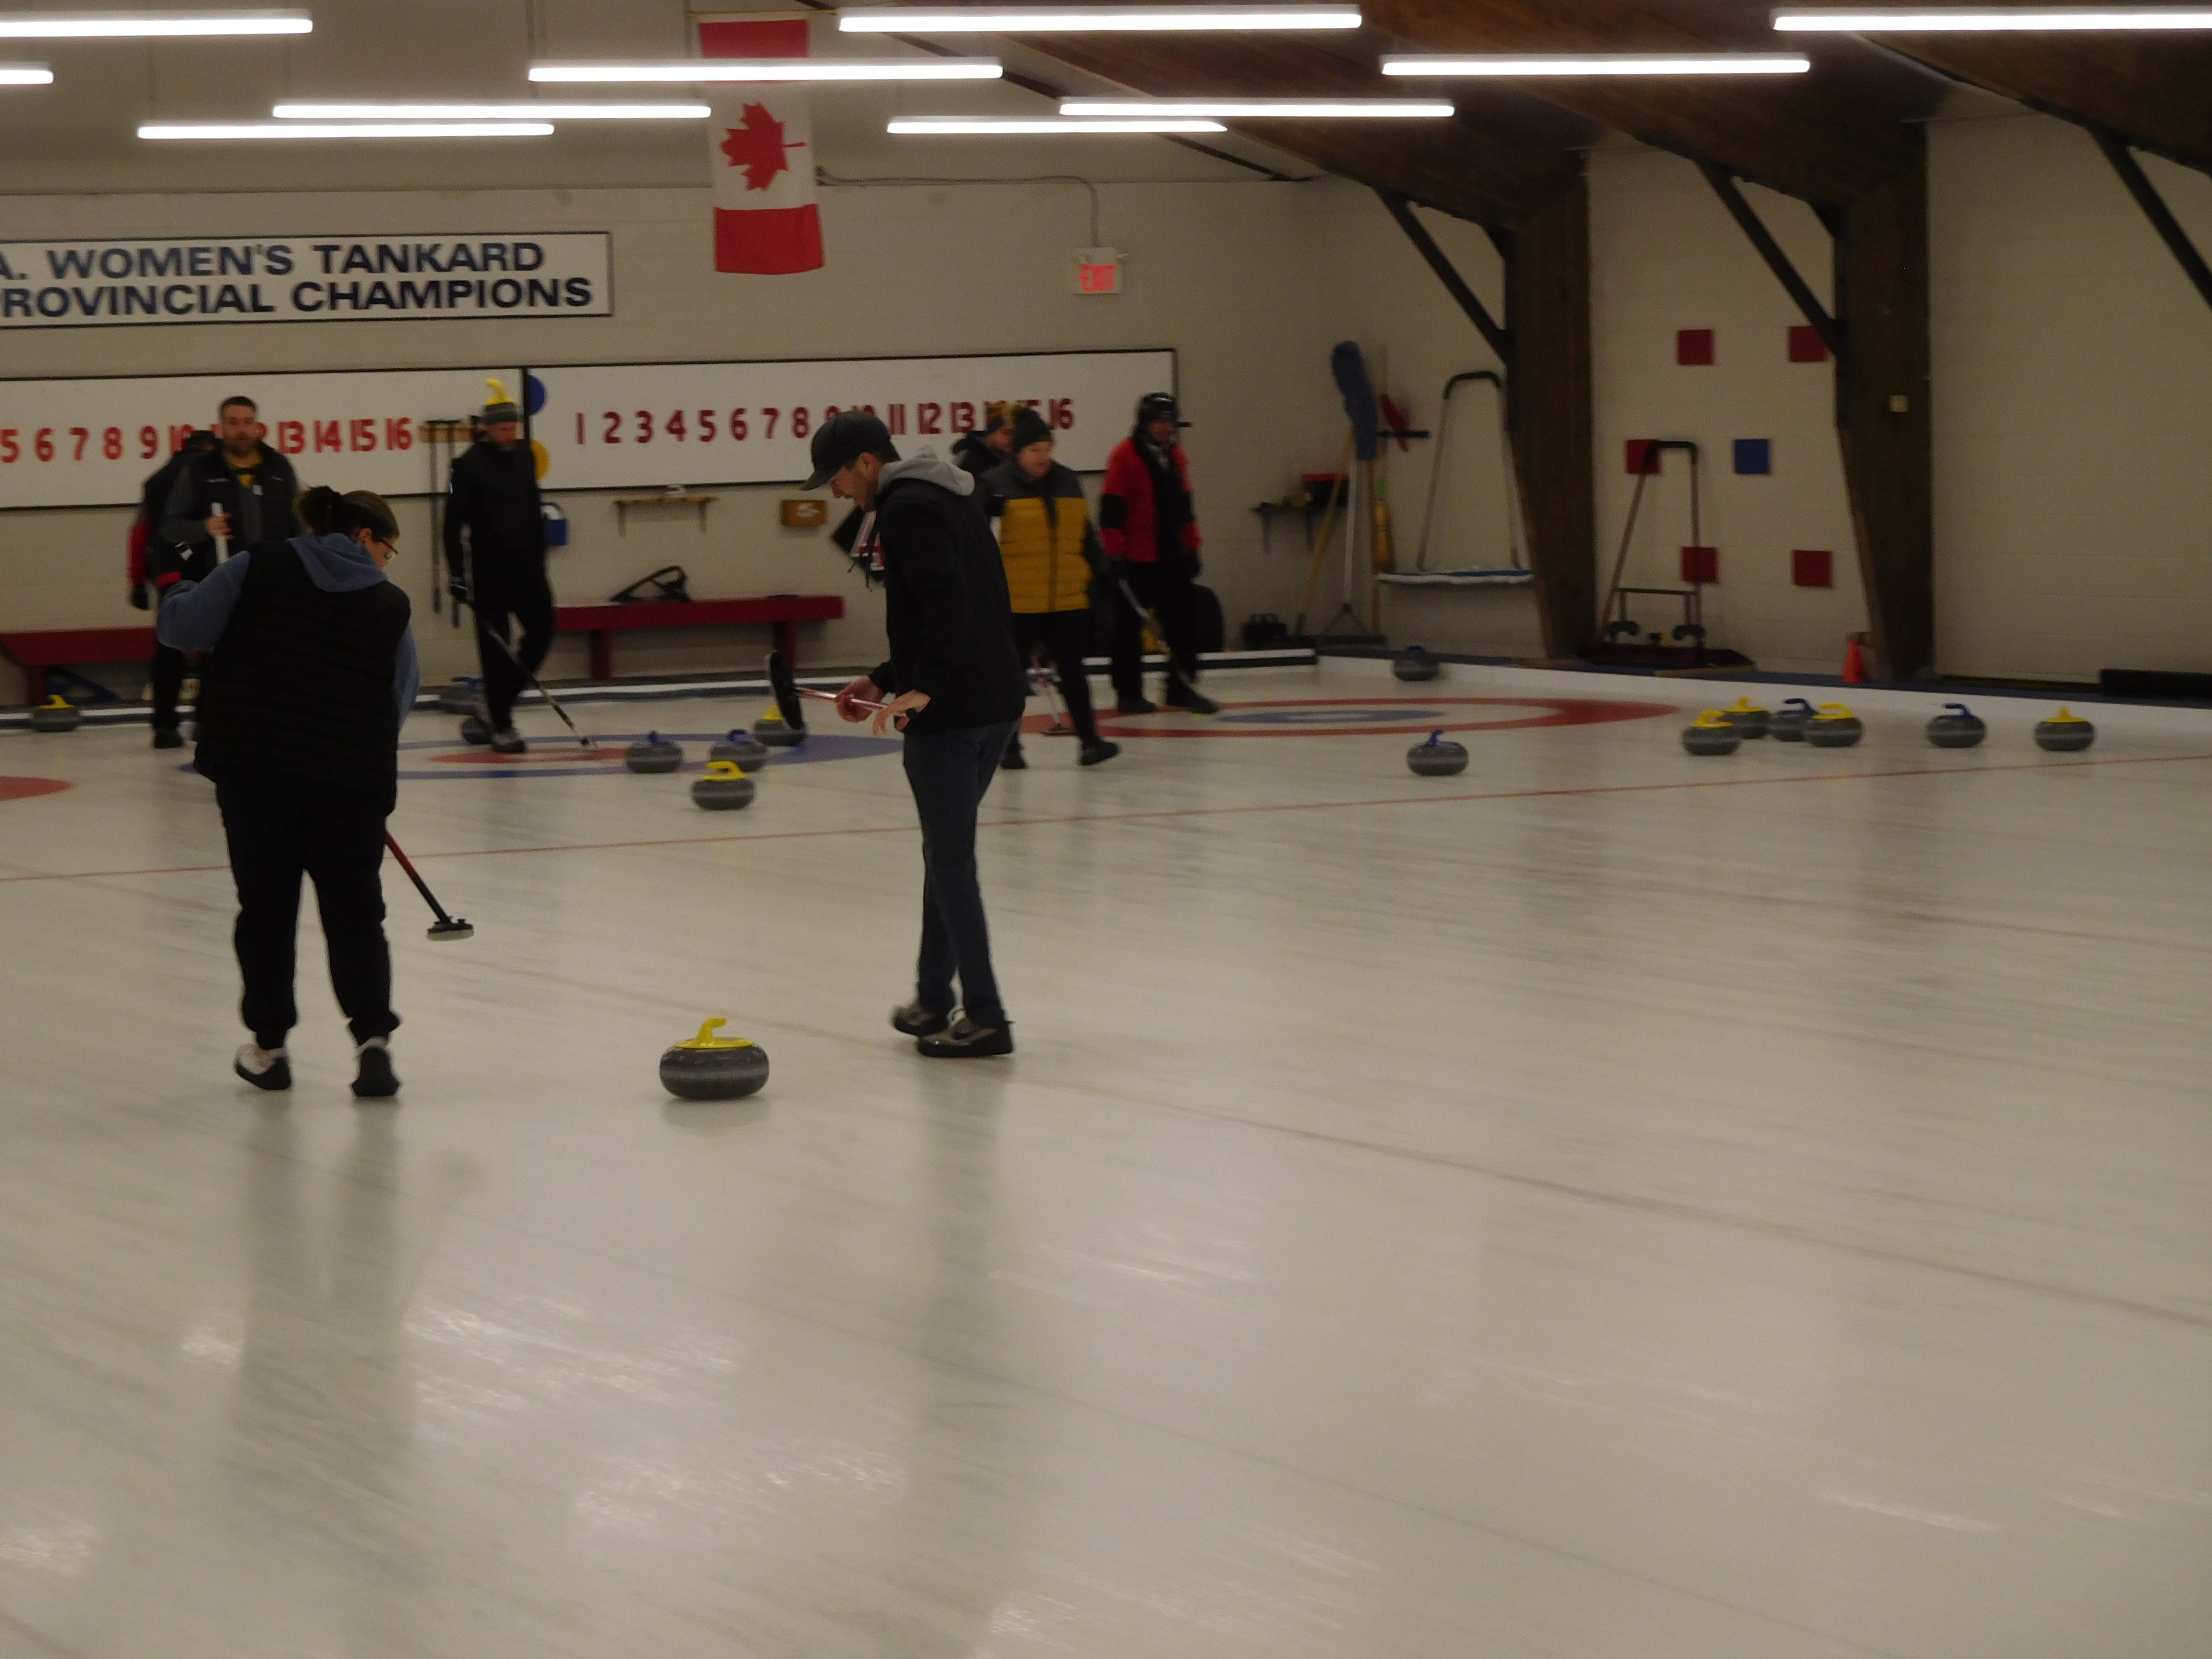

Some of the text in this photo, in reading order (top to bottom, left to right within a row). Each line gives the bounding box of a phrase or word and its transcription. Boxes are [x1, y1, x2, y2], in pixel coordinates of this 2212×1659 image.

[46, 244, 294, 280] WOMEN'S
[311, 242, 545, 275] TANKARD
[0, 276, 593, 318] ROVINCIAL CHAMPIONS
[0, 428, 21, 464] 5
[34, 427, 55, 462] 6
[70, 427, 90, 461] 7
[102, 426, 124, 460] 8
[139, 424, 159, 460] 9
[277, 420, 307, 455] 13
[313, 419, 343, 453] 14
[349, 418, 377, 452] 15
[385, 417, 413, 451] 16
[576, 412, 586, 445] 1
[603, 411, 622, 444] 2
[636, 409, 653, 444] 3
[665, 409, 687, 442] 4
[698, 409, 717, 443] 5
[730, 408, 748, 441] 6
[762, 407, 780, 439] 7
[792, 407, 809, 438] 8
[888, 404, 907, 435] 11
[917, 402, 942, 434] 12
[950, 401, 976, 433] 13
[1048, 398, 1073, 430] 16
